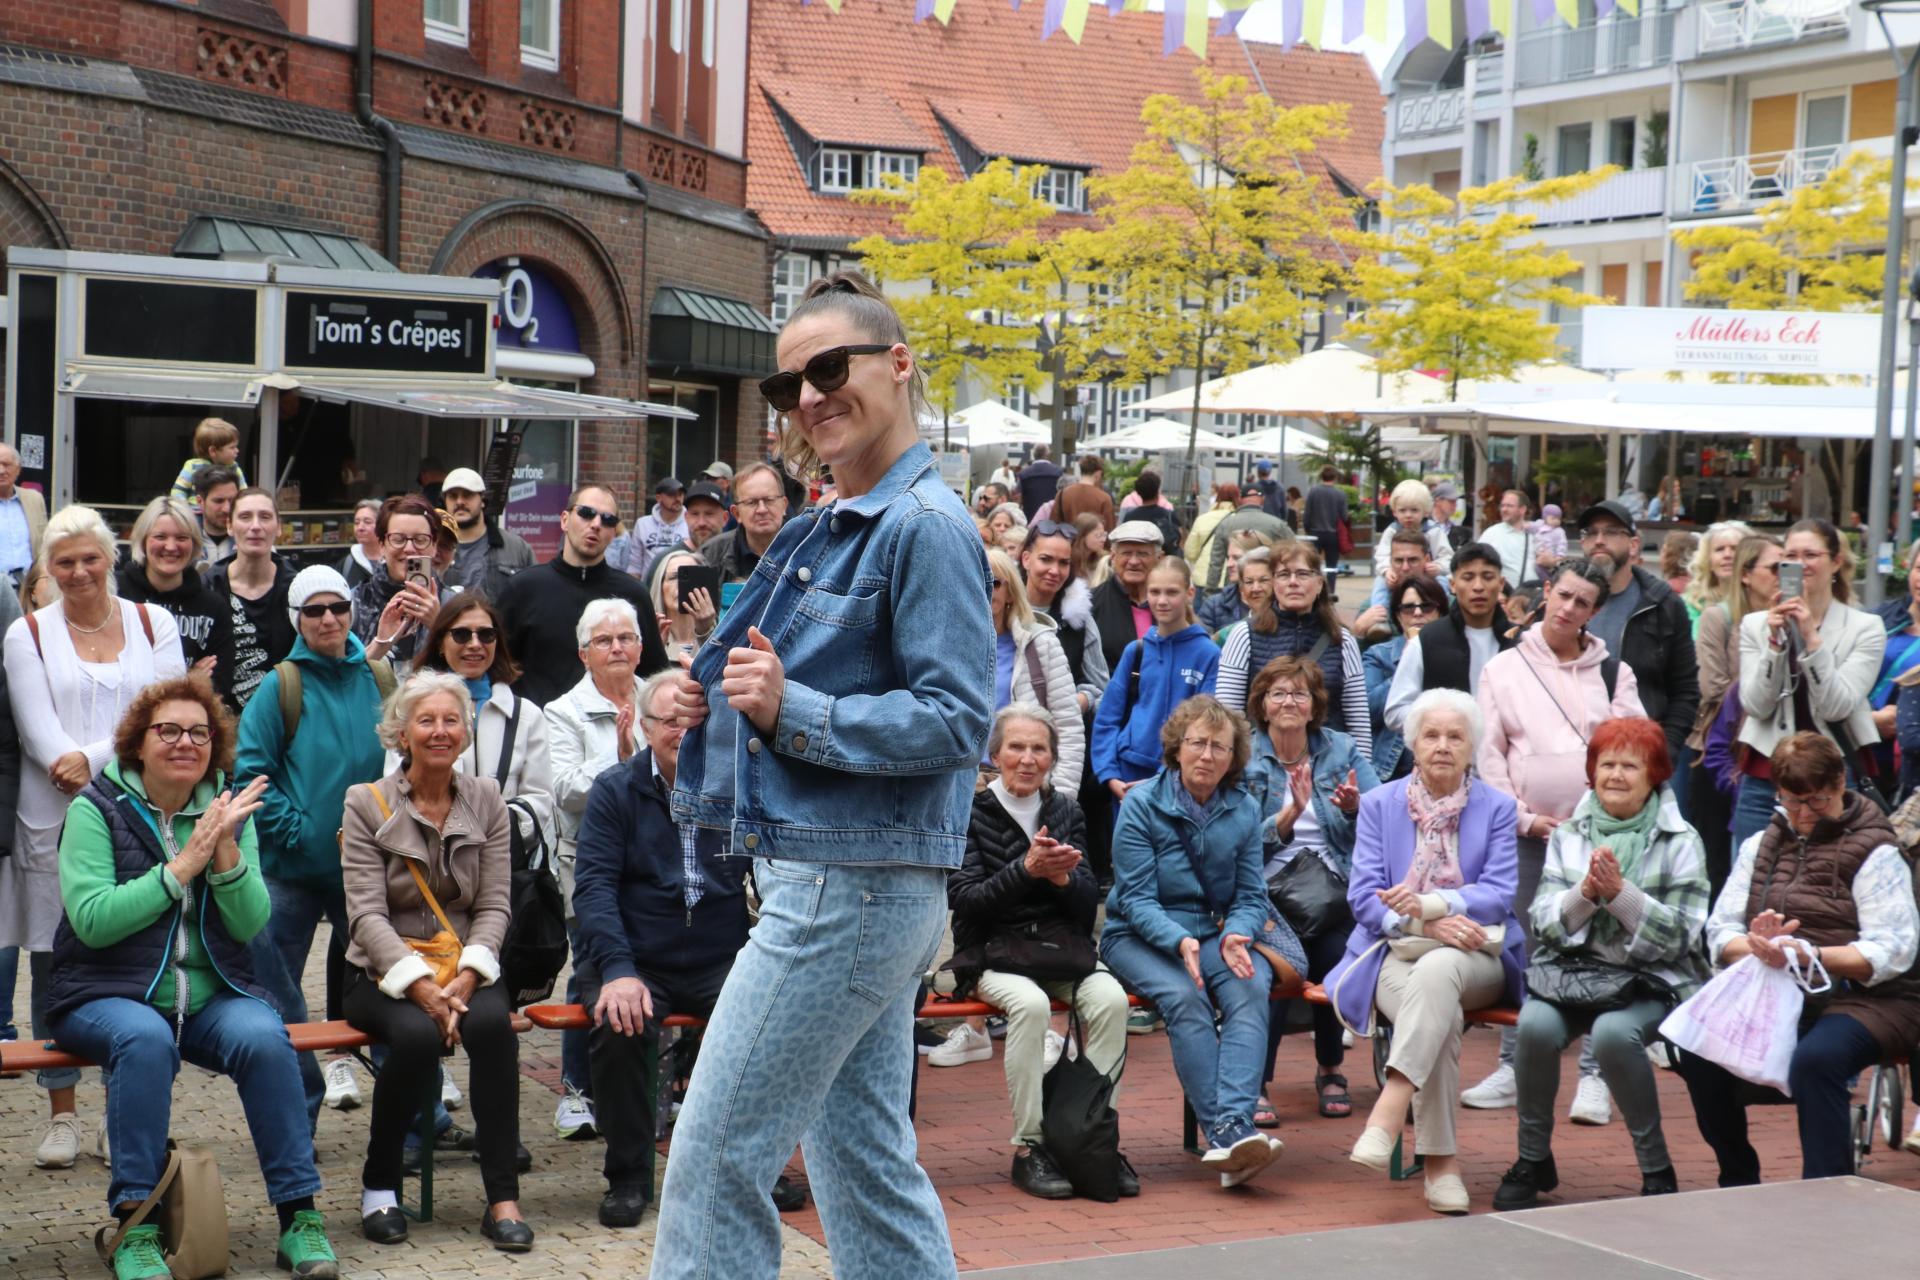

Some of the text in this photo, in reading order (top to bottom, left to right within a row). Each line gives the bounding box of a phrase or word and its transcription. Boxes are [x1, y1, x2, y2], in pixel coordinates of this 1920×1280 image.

[388, 320, 461, 353] Crêpes
[1676, 316, 1821, 344] Müllers Eck
[512, 464, 544, 479] ourfone
